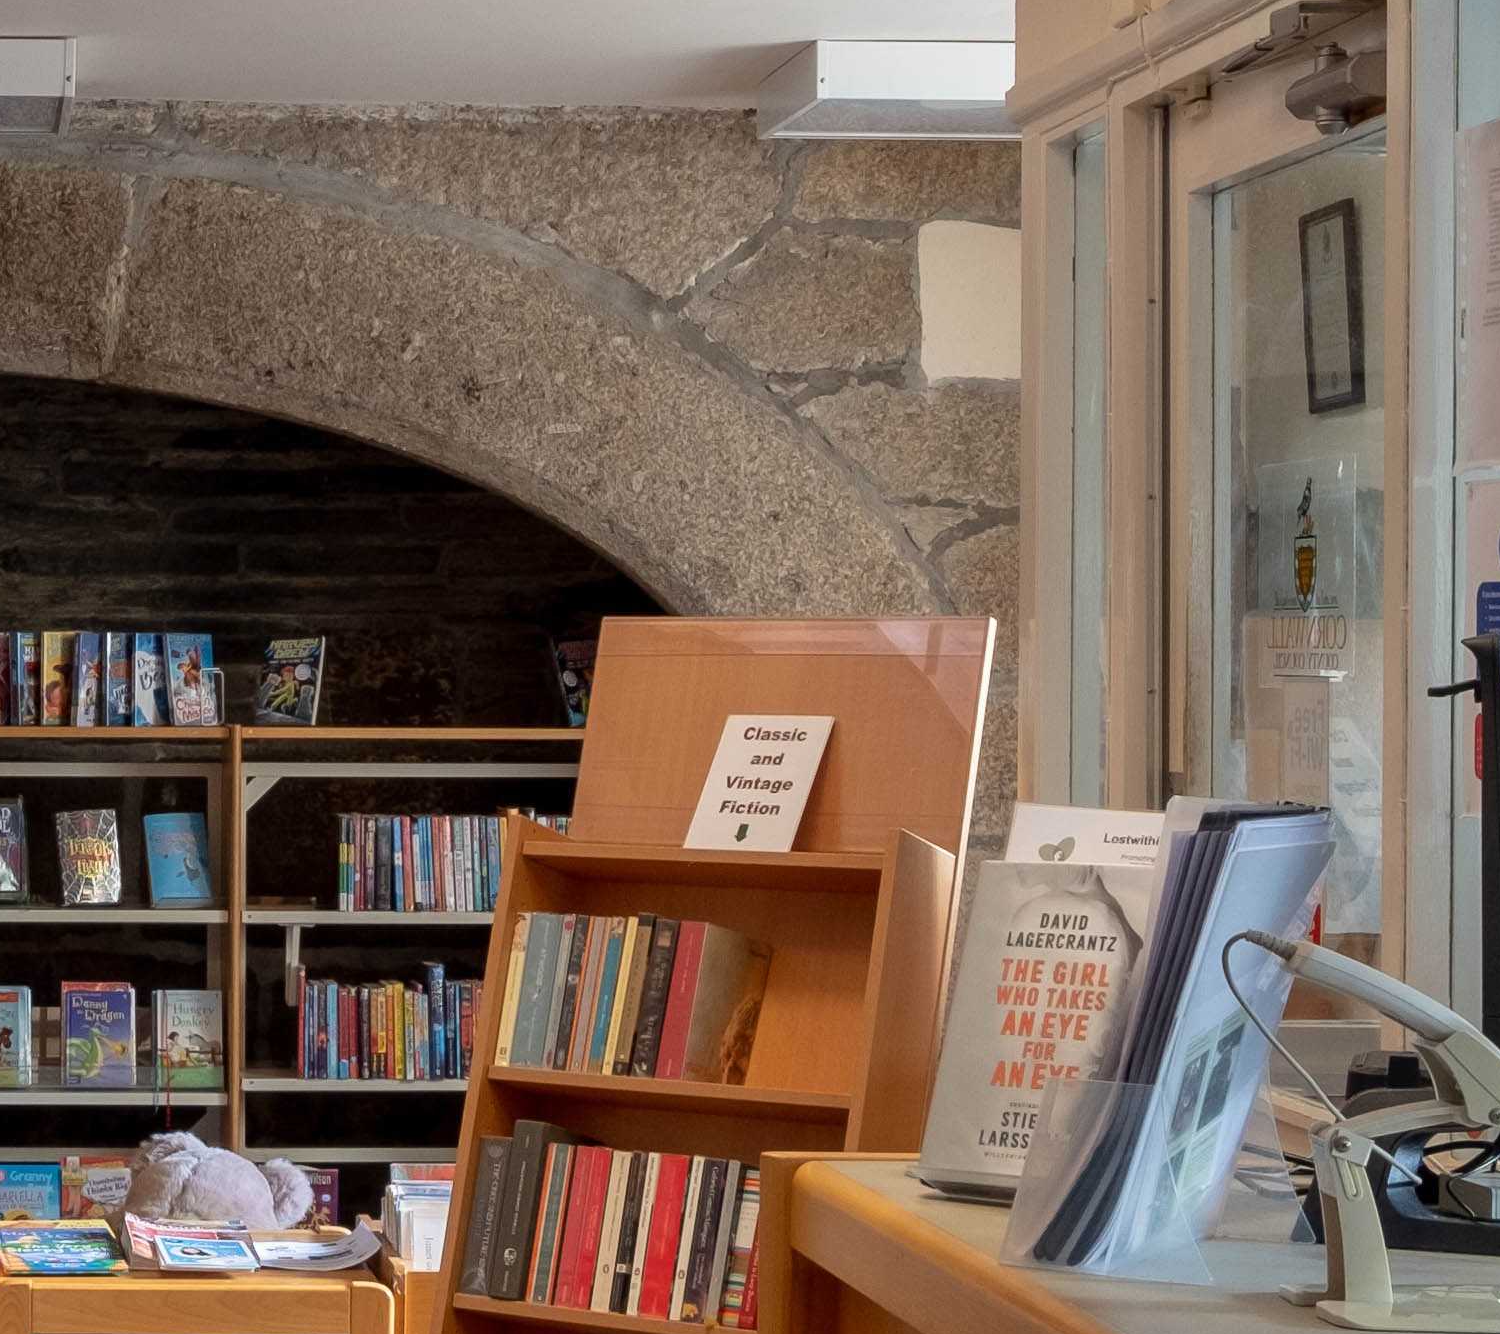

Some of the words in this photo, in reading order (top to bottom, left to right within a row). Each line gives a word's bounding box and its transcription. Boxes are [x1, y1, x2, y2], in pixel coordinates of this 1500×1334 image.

[742, 726, 809, 743] Classic
[749, 752, 785, 767] and
[725, 775, 794, 795] Vintage
[717, 799, 782, 816] Fiction
[1039, 912, 1090, 933] DAVID
[1005, 930, 1119, 954] LAGERCRANTZ
[1000, 957, 1046, 985] THE
[1052, 961, 1111, 988] GIRL
[71, 996, 109, 1011] Danny
[995, 984, 1040, 1008] WHO
[1046, 987, 1108, 1013] TAKES
[84, 1008, 126, 1023] Dragon
[999, 1010, 1037, 1037] AN
[1040, 1012, 1091, 1042] EYE
[1021, 1040, 1058, 1061] FOR
[988, 1059, 1027, 1089] AN
[9, 1169, 53, 1185] Granny
